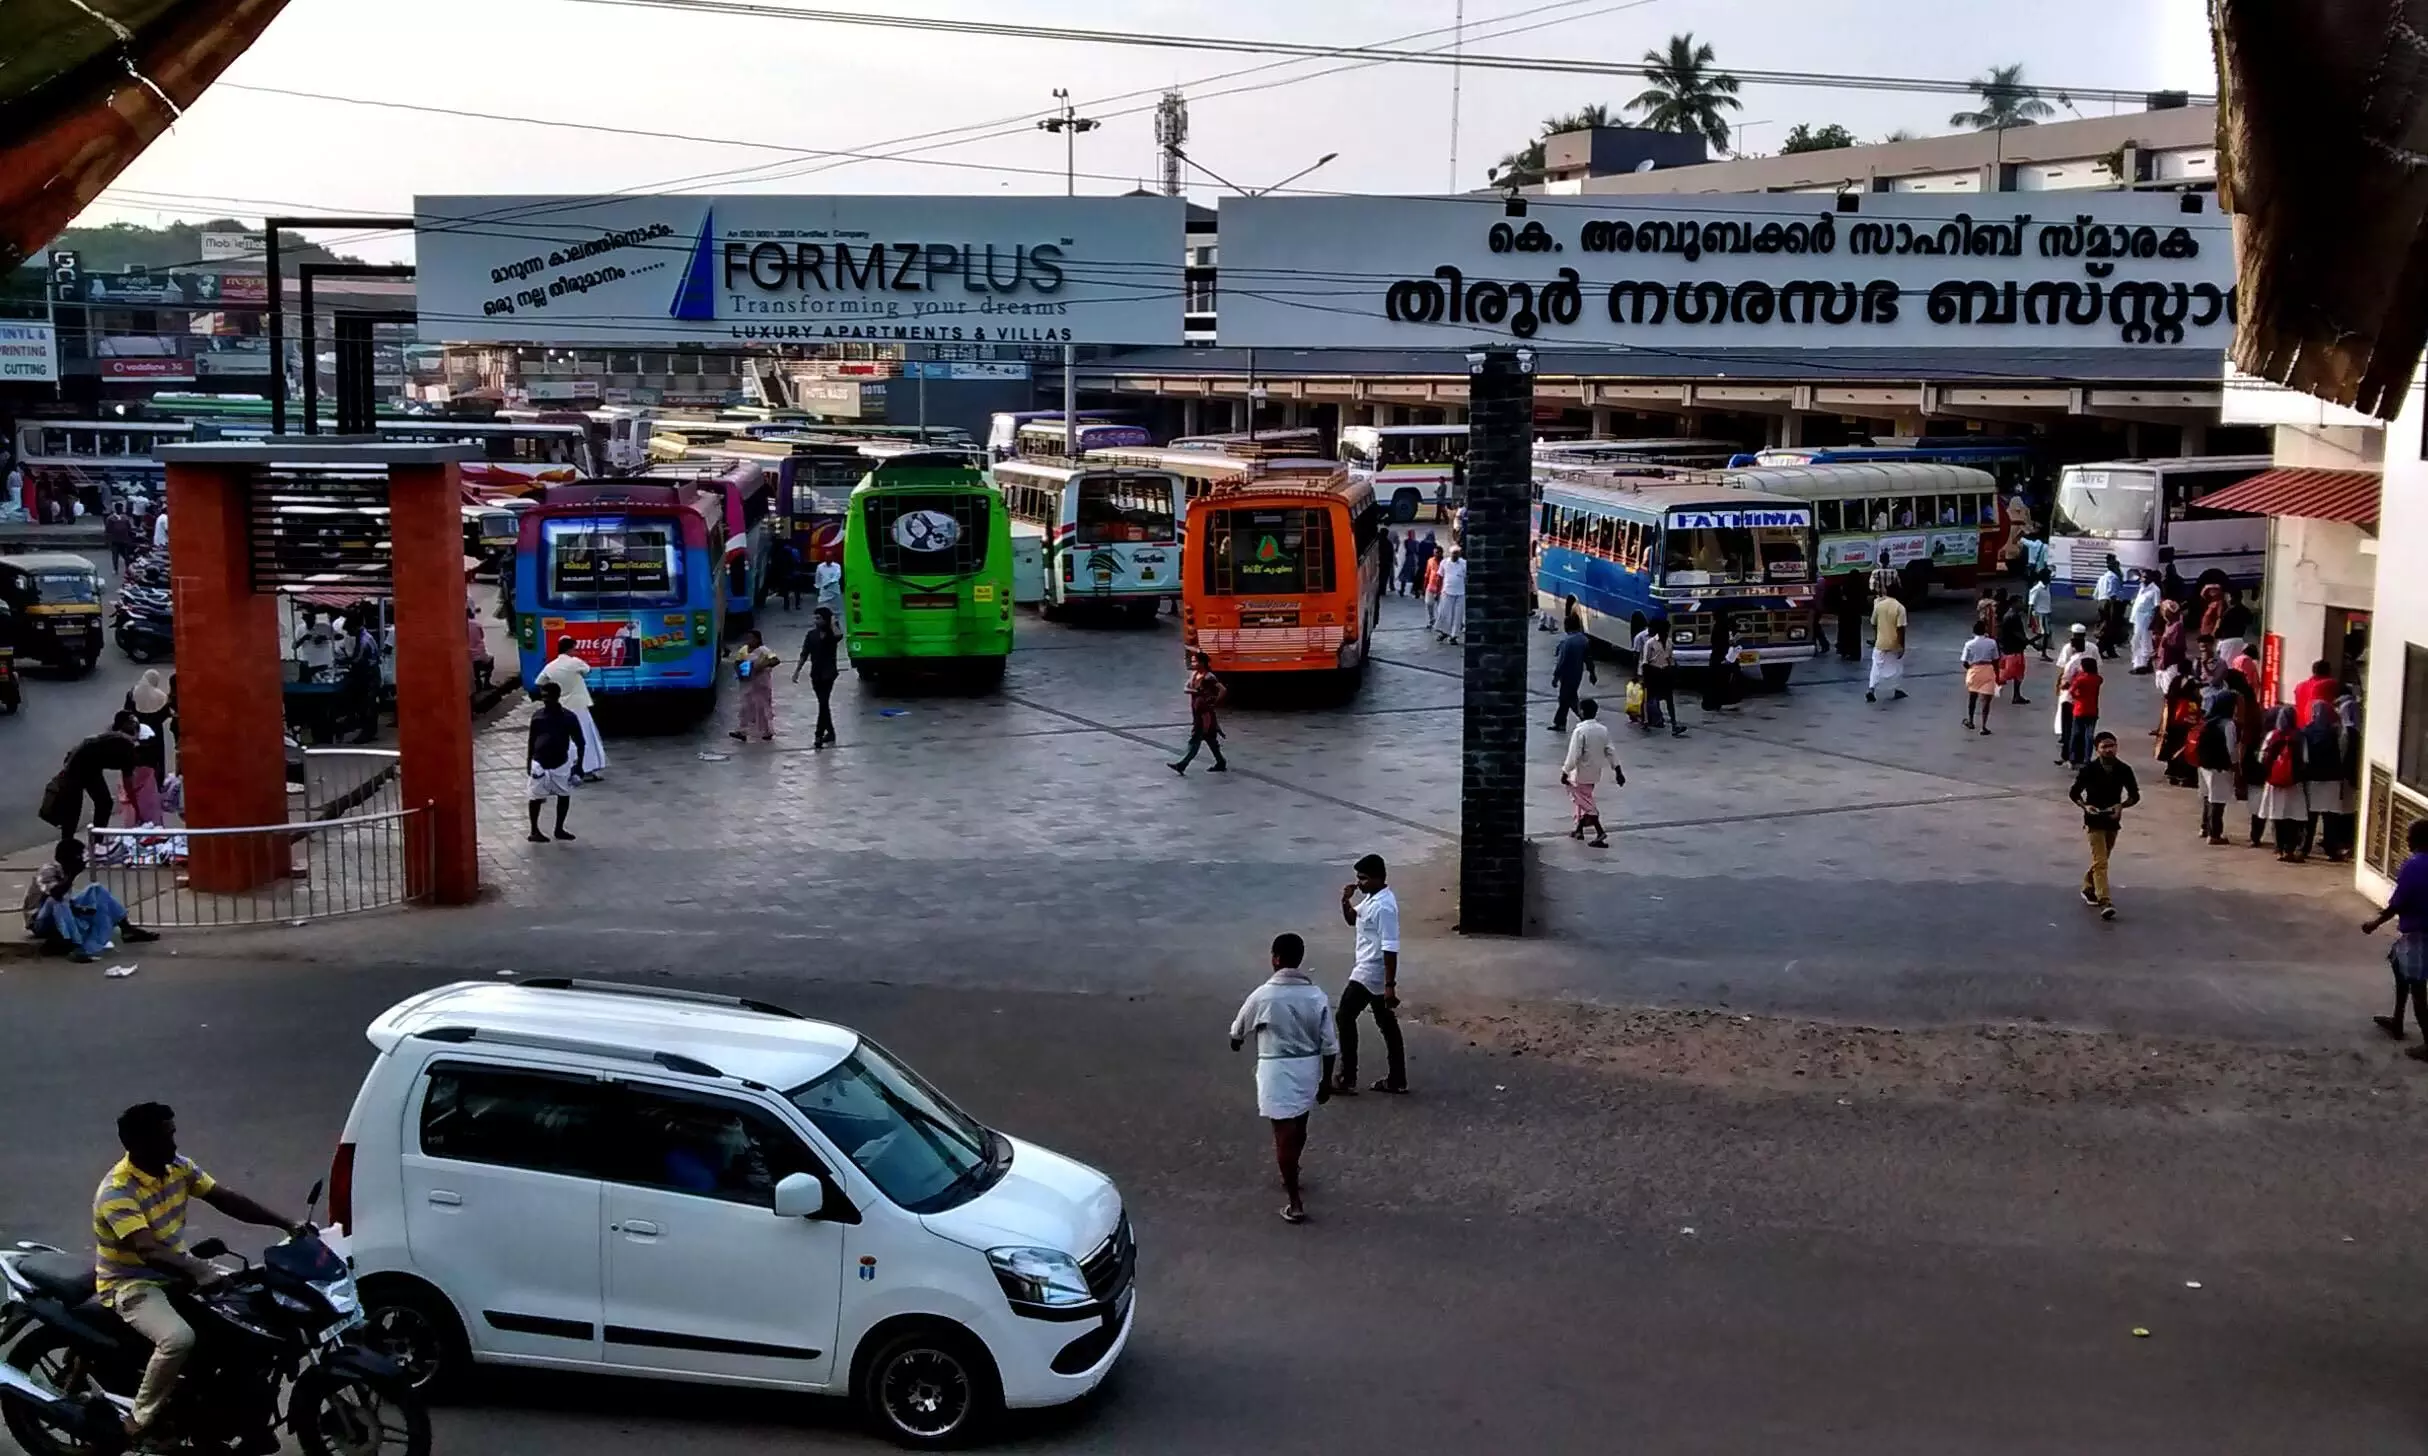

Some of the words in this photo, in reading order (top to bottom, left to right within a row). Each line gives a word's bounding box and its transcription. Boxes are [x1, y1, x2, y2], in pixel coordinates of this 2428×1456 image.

[1488, 220, 1564, 253] കെ.
[1850, 213, 2032, 257] സാഹിബ്
[2040, 214, 2199, 258] സ്മാരക
[724, 241, 1066, 293] FORMZPLUS
[730, 295, 900, 318] Transforming
[911, 297, 970, 319] your
[980, 294, 1068, 316] dreams
[1385, 265, 1583, 338] തിരൂർ
[1608, 279, 1900, 325] നഗരസഭ
[732, 325, 813, 339] LUXURY
[823, 325, 963, 341] APARTMENTS
[974, 326, 986, 341] &
[997, 326, 1073, 341] VILLAS
[4, 363, 47, 375] CUTTING
[125, 363, 166, 372] vodafone
[1678, 512, 1804, 527] FATHIMA
